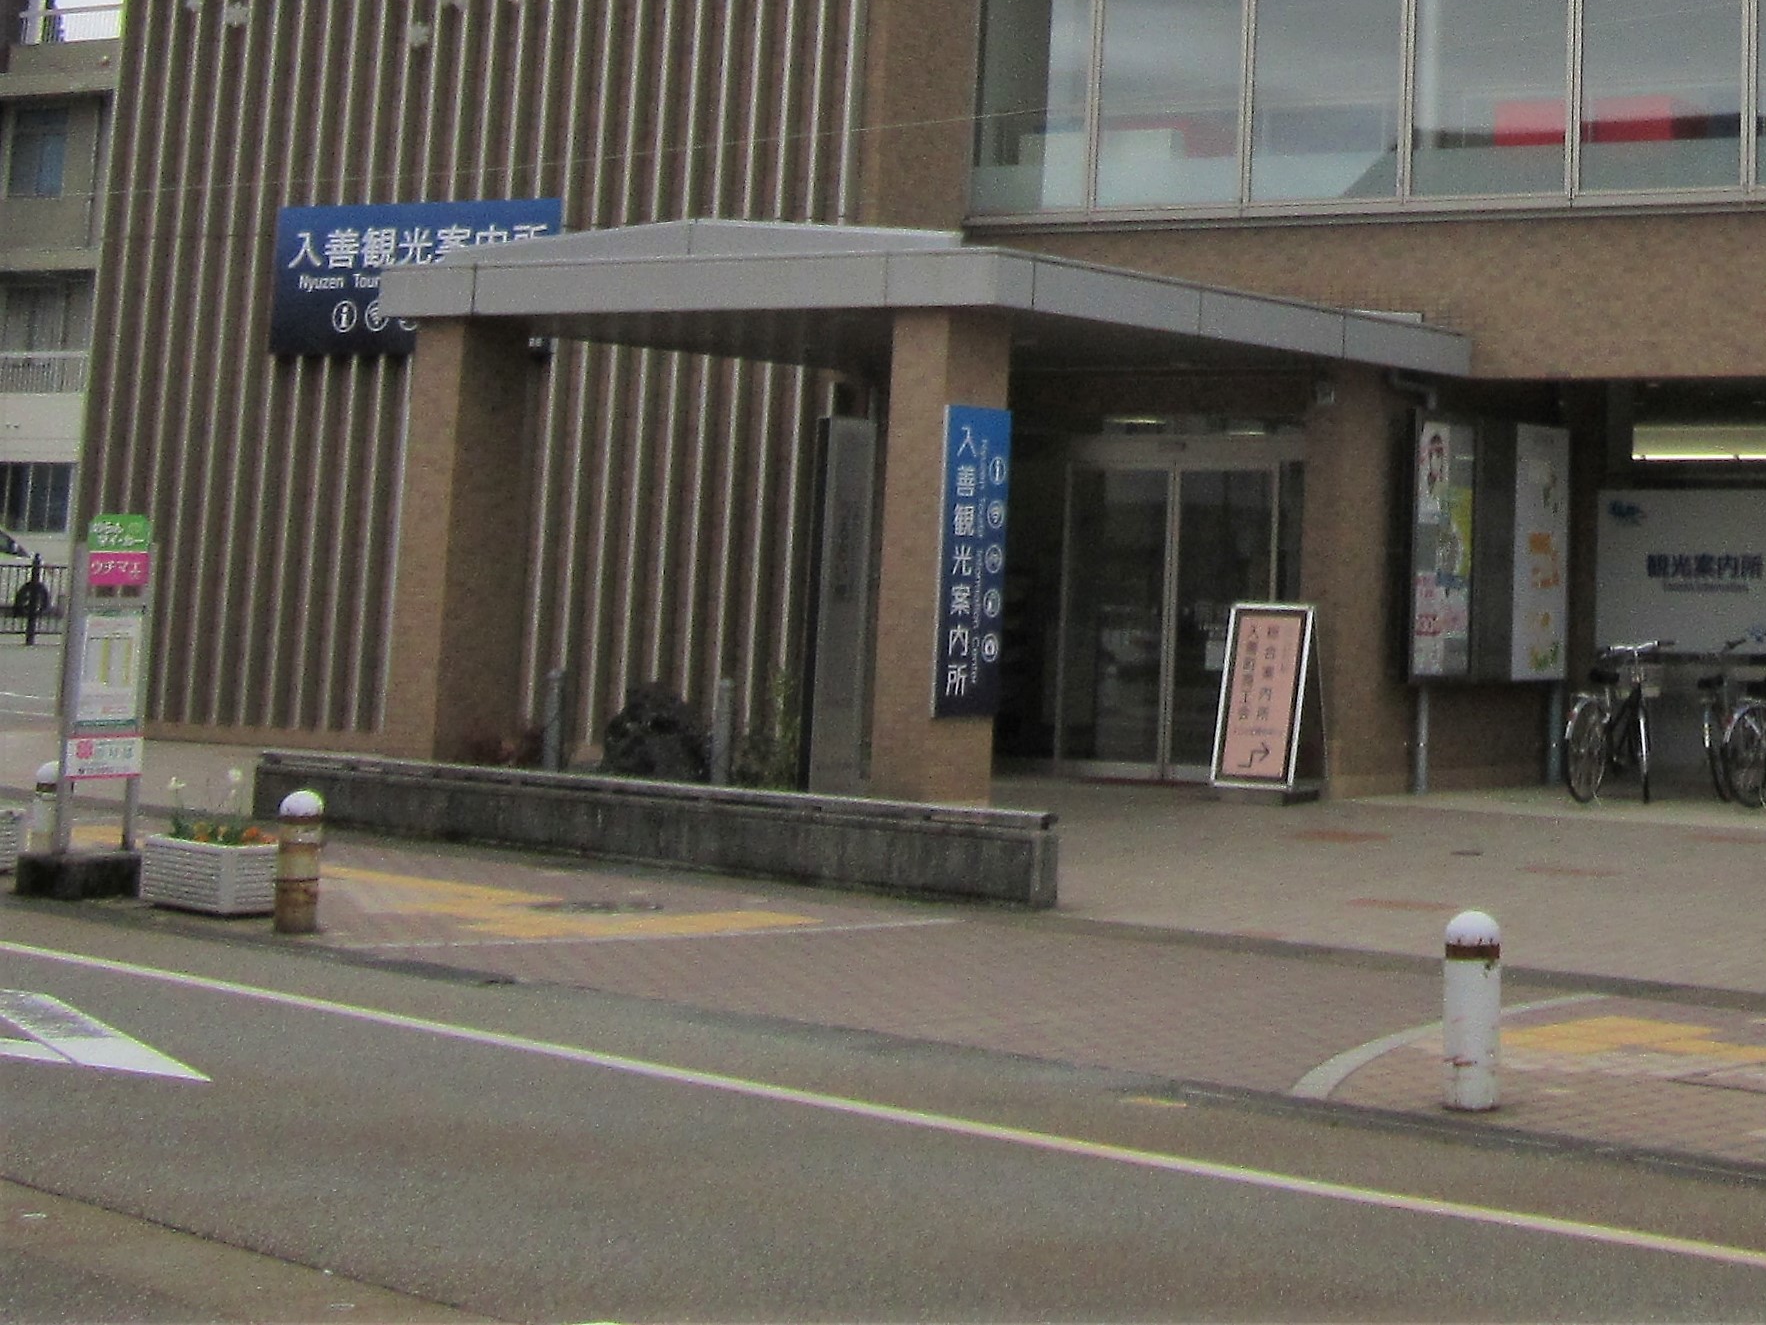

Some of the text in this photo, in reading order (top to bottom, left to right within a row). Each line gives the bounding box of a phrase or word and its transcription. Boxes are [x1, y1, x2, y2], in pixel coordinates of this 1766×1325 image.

[299, 273, 381, 292] Nyuzen Tour
[945, 426, 977, 696] 入善観光案内所
[1647, 553, 1763, 578] 観光案内所
